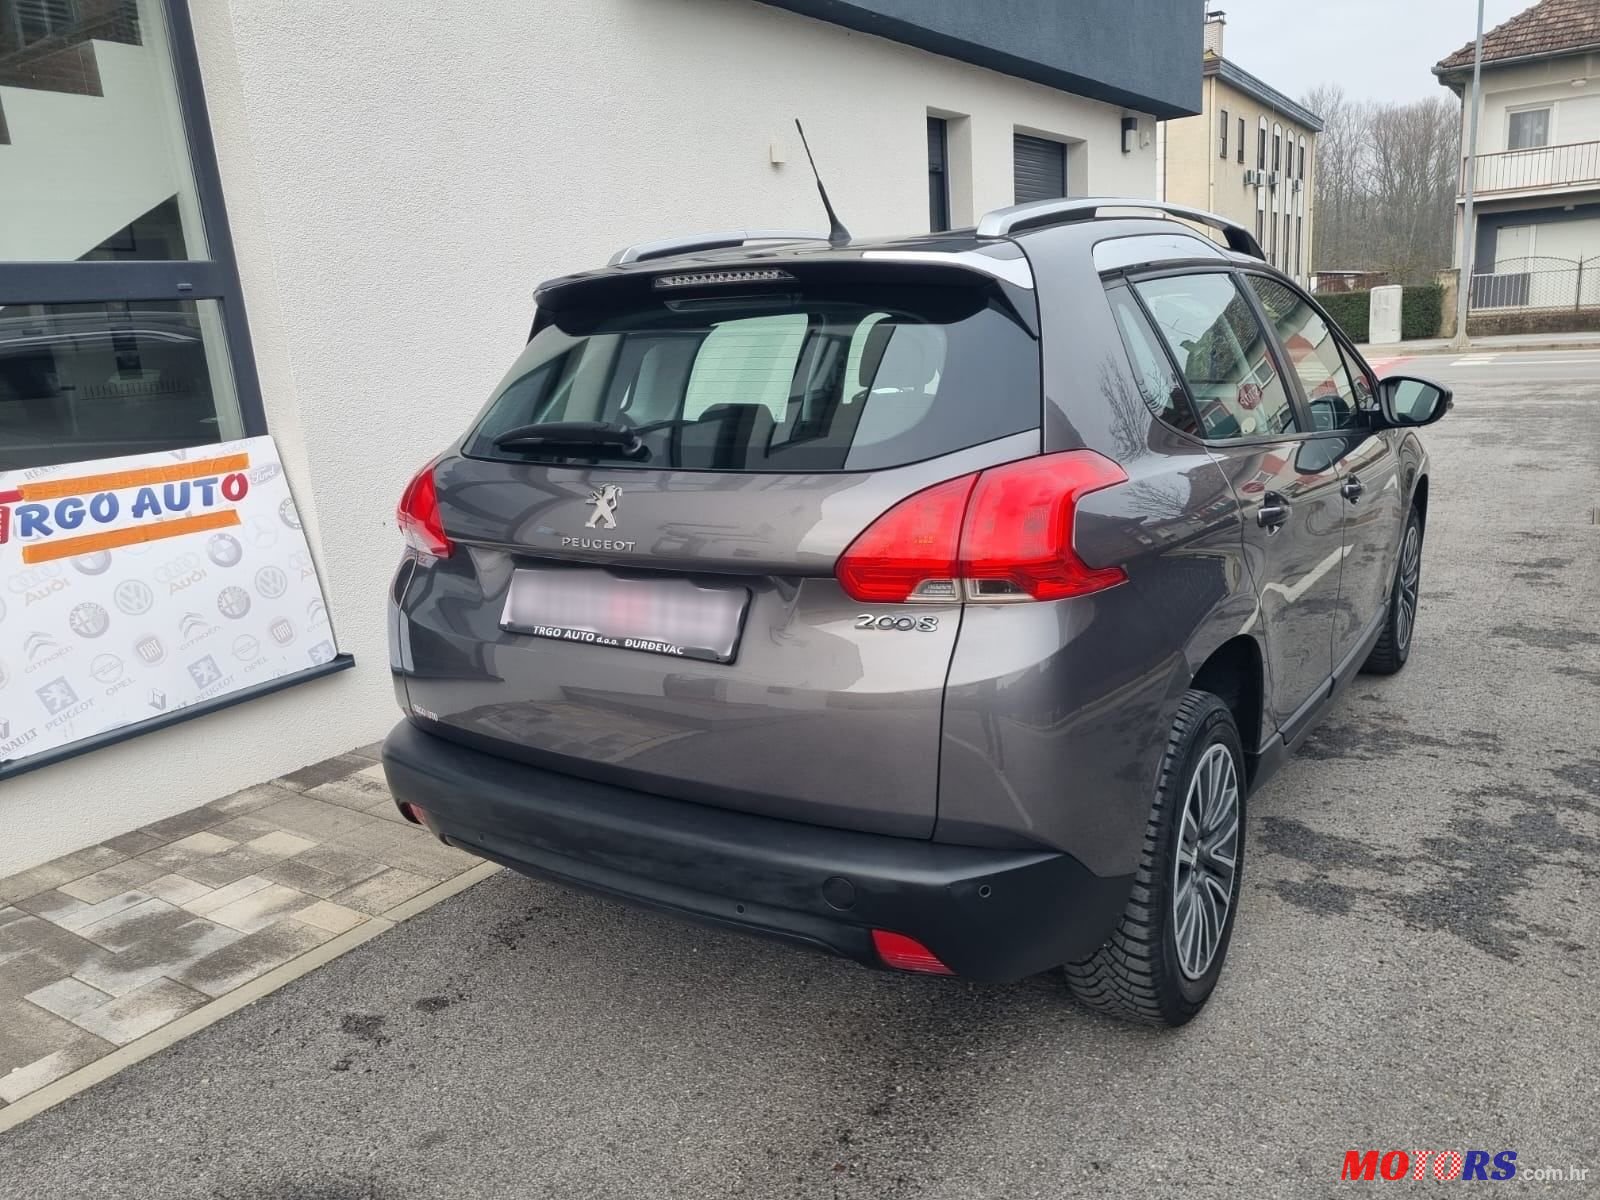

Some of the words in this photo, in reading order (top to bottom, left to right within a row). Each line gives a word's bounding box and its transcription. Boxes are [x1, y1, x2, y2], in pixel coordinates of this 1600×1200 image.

[131, 473, 249, 519] AUTO
[561, 536, 636, 552] PEUGEOT
[854, 613, 939, 632] 2008
[533, 625, 562, 638] TRGO
[563, 628, 595, 642] AUTO
[624, 638, 684, 655] ĐURĐEVAC
[105, 677, 136, 696] OPEL
[44, 698, 95, 731] PEUGEOT
